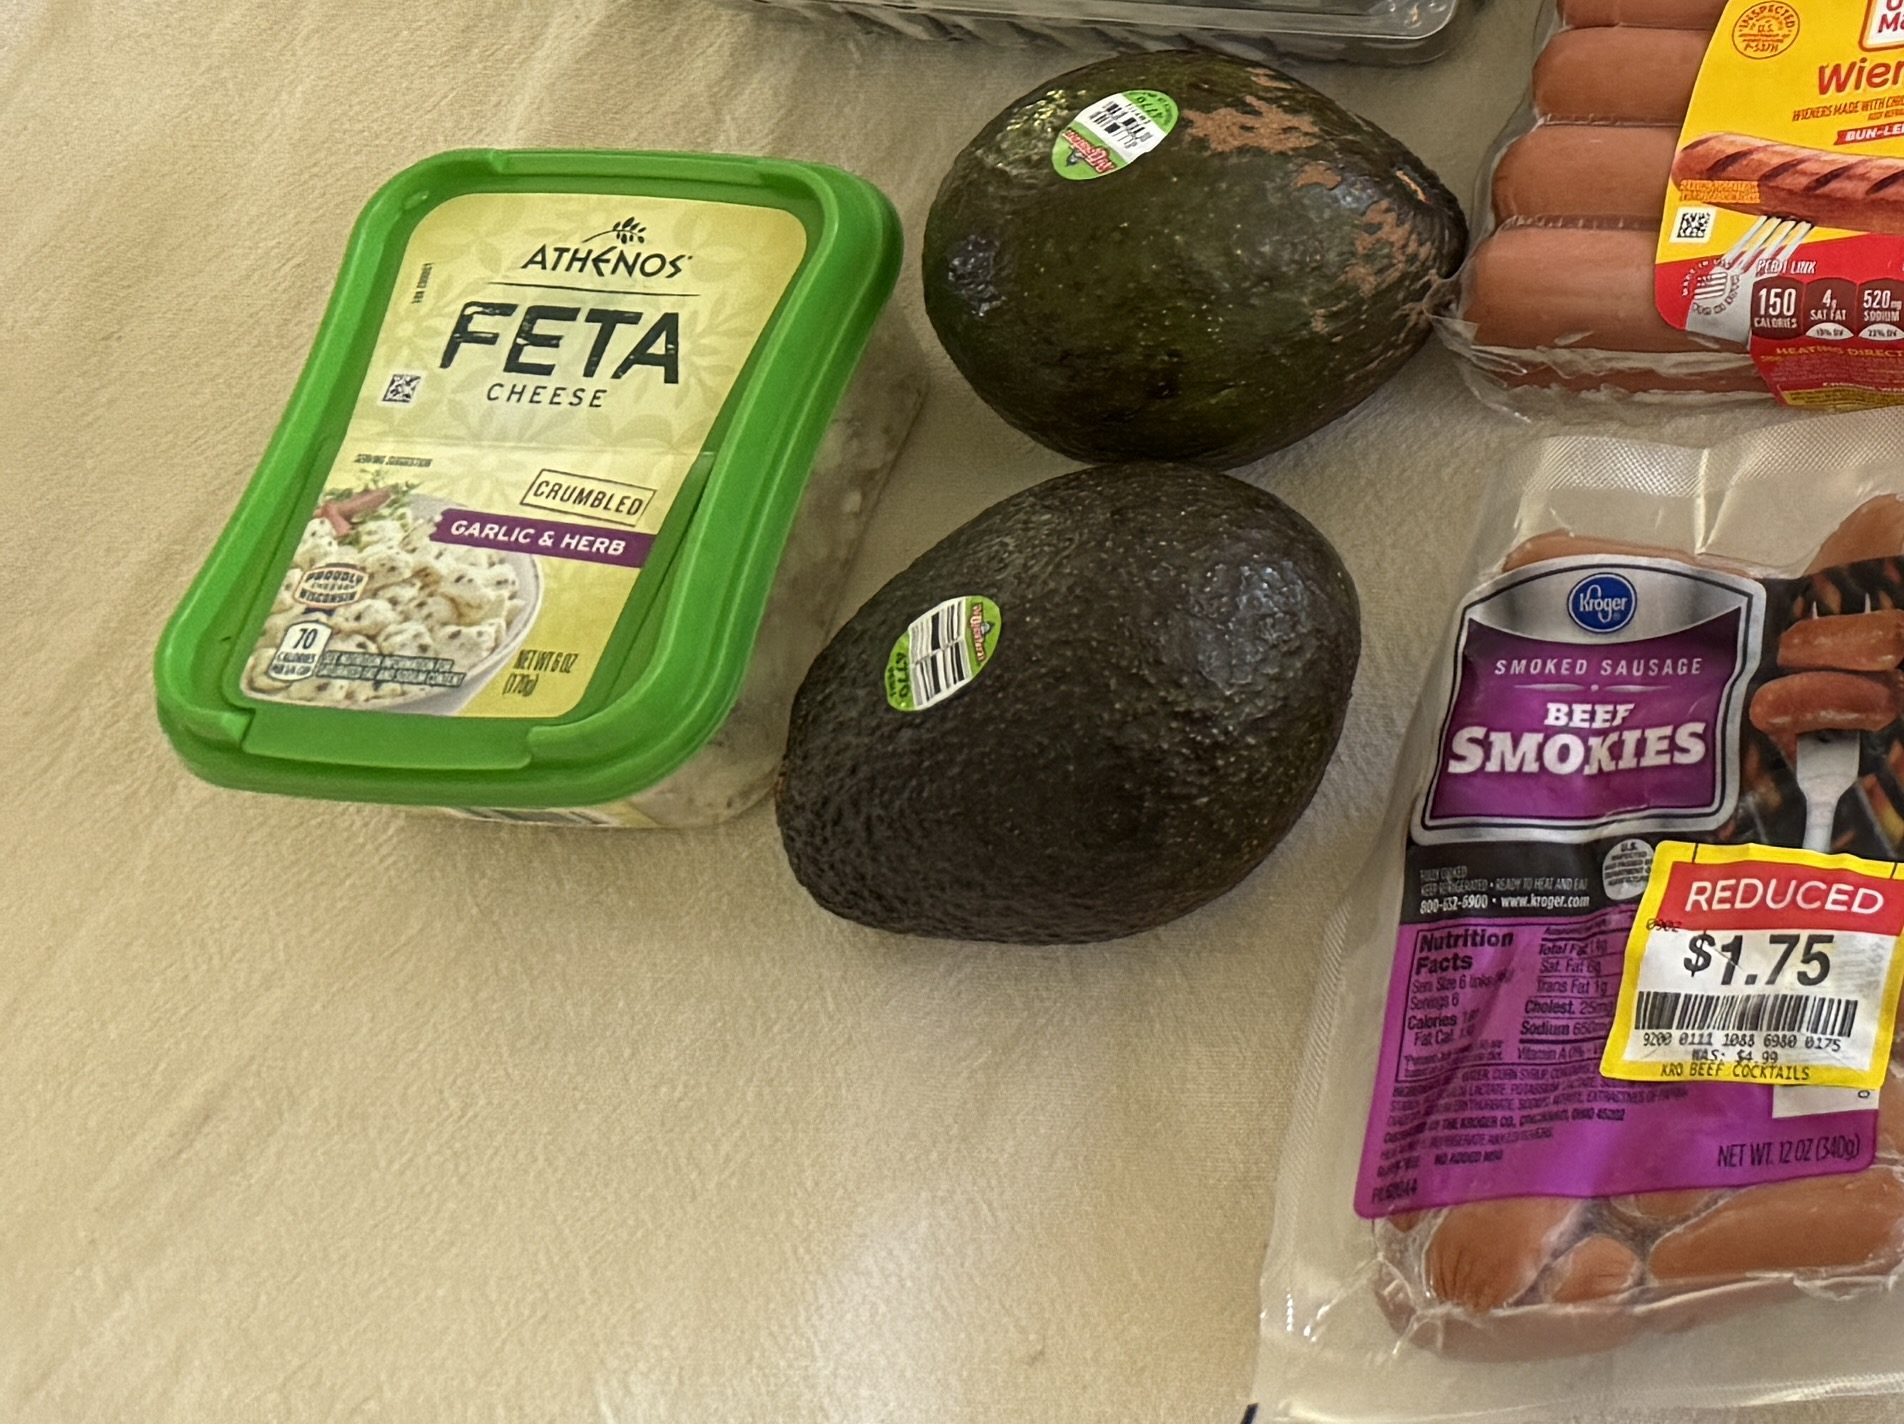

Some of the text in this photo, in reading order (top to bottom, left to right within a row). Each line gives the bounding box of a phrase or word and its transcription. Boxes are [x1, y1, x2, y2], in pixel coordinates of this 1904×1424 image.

[521, 243, 687, 279] ATHENOS
[1757, 288, 1796, 315] 150
[438, 300, 681, 385] FETA
[485, 382, 609, 410] CHEESE
[532, 478, 645, 520] CRUMBLED
[449, 518, 626, 557] GARLIC & HERB
[1494, 656, 1703, 677] SMOKED SAUSAGE
[1543, 702, 1635, 729] BEEF
[1446, 722, 1707, 776] SMOKIES
[1500, 894, 1591, 911] www.kroger.com
[1685, 880, 1886, 914] REDUCED
[1683, 933, 1835, 988] $1.75
